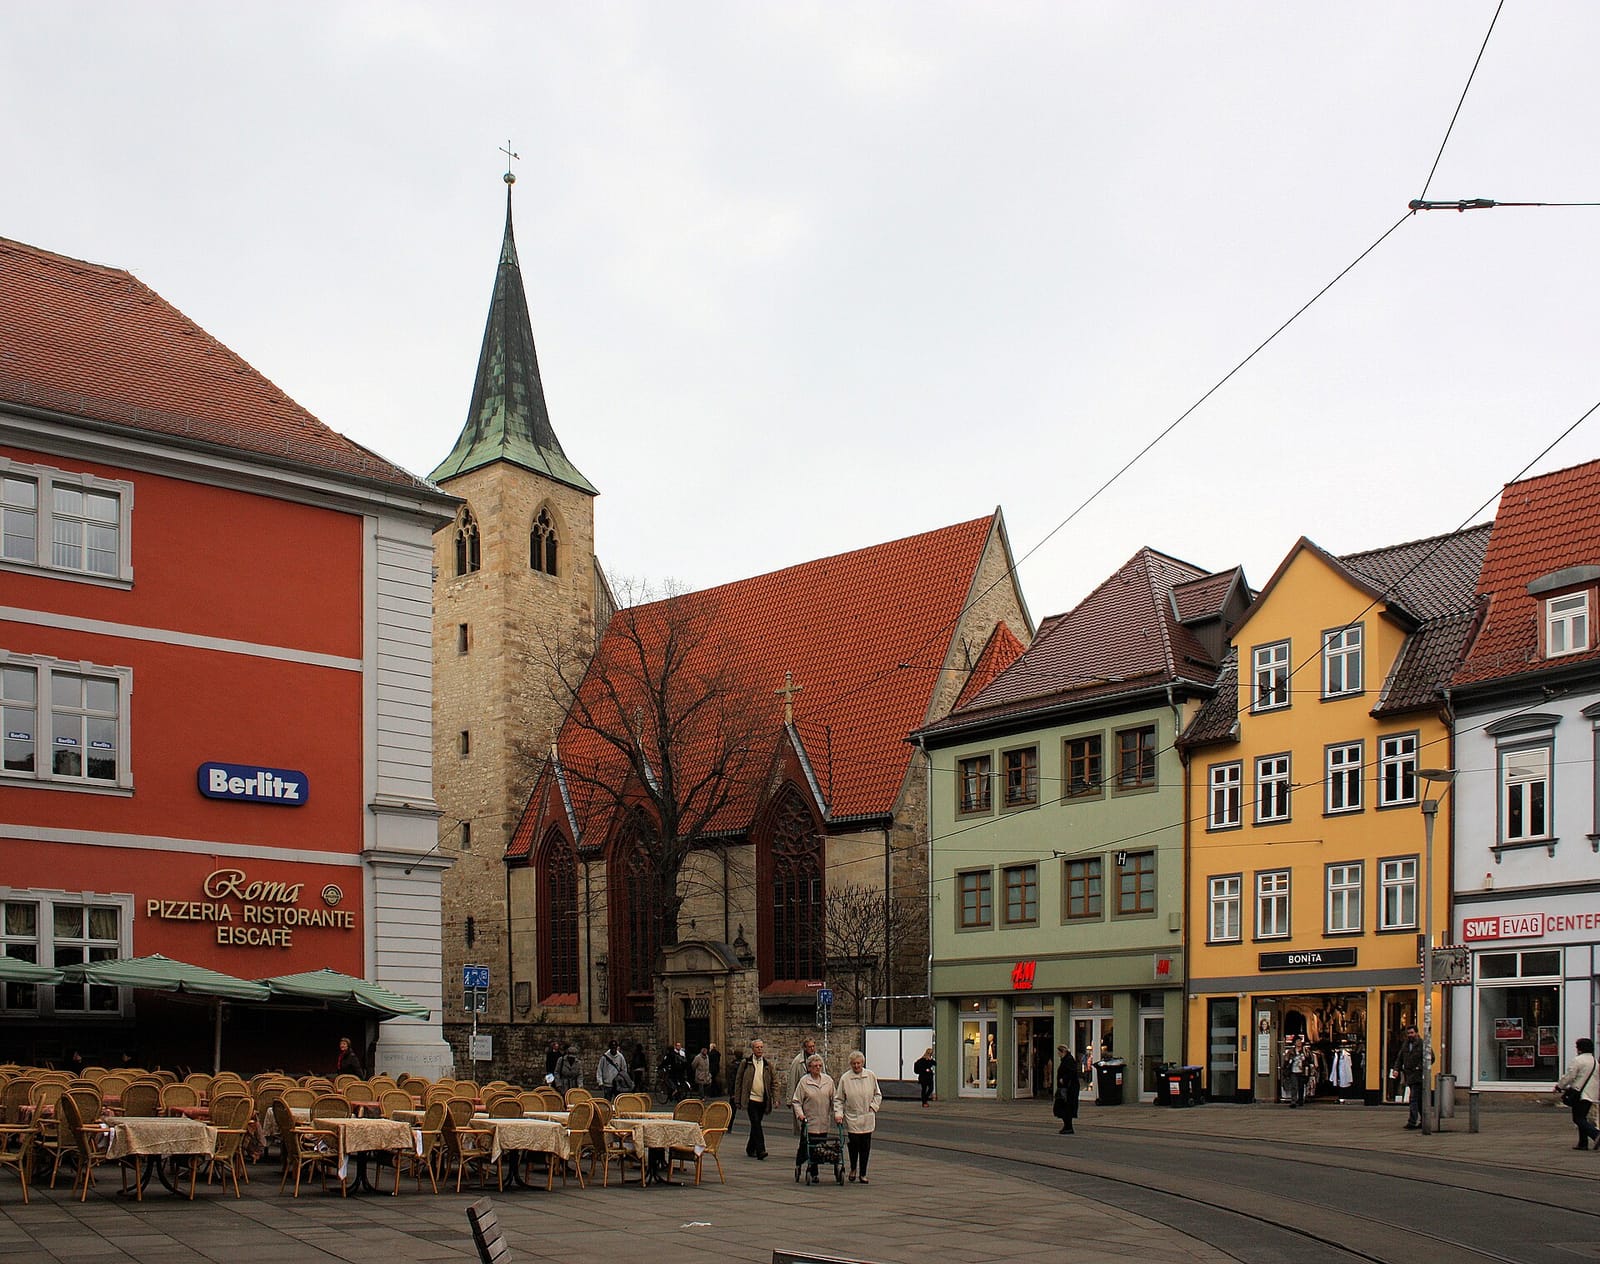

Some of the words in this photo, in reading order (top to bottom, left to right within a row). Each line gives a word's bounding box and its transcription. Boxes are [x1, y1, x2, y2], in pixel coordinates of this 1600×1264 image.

[209, 768, 299, 799] Berlitz
[1118, 852, 1126, 865] H
[204, 869, 304, 903] Roma
[147, 899, 232, 921] PIZZERIA
[244, 905, 355, 928] RISTORANTE
[217, 926, 293, 947] EISCAFÈ
[1466, 920, 1497, 937] SWE
[1503, 917, 1539, 934] EVAG
[1288, 953, 1322, 965] BONITA
